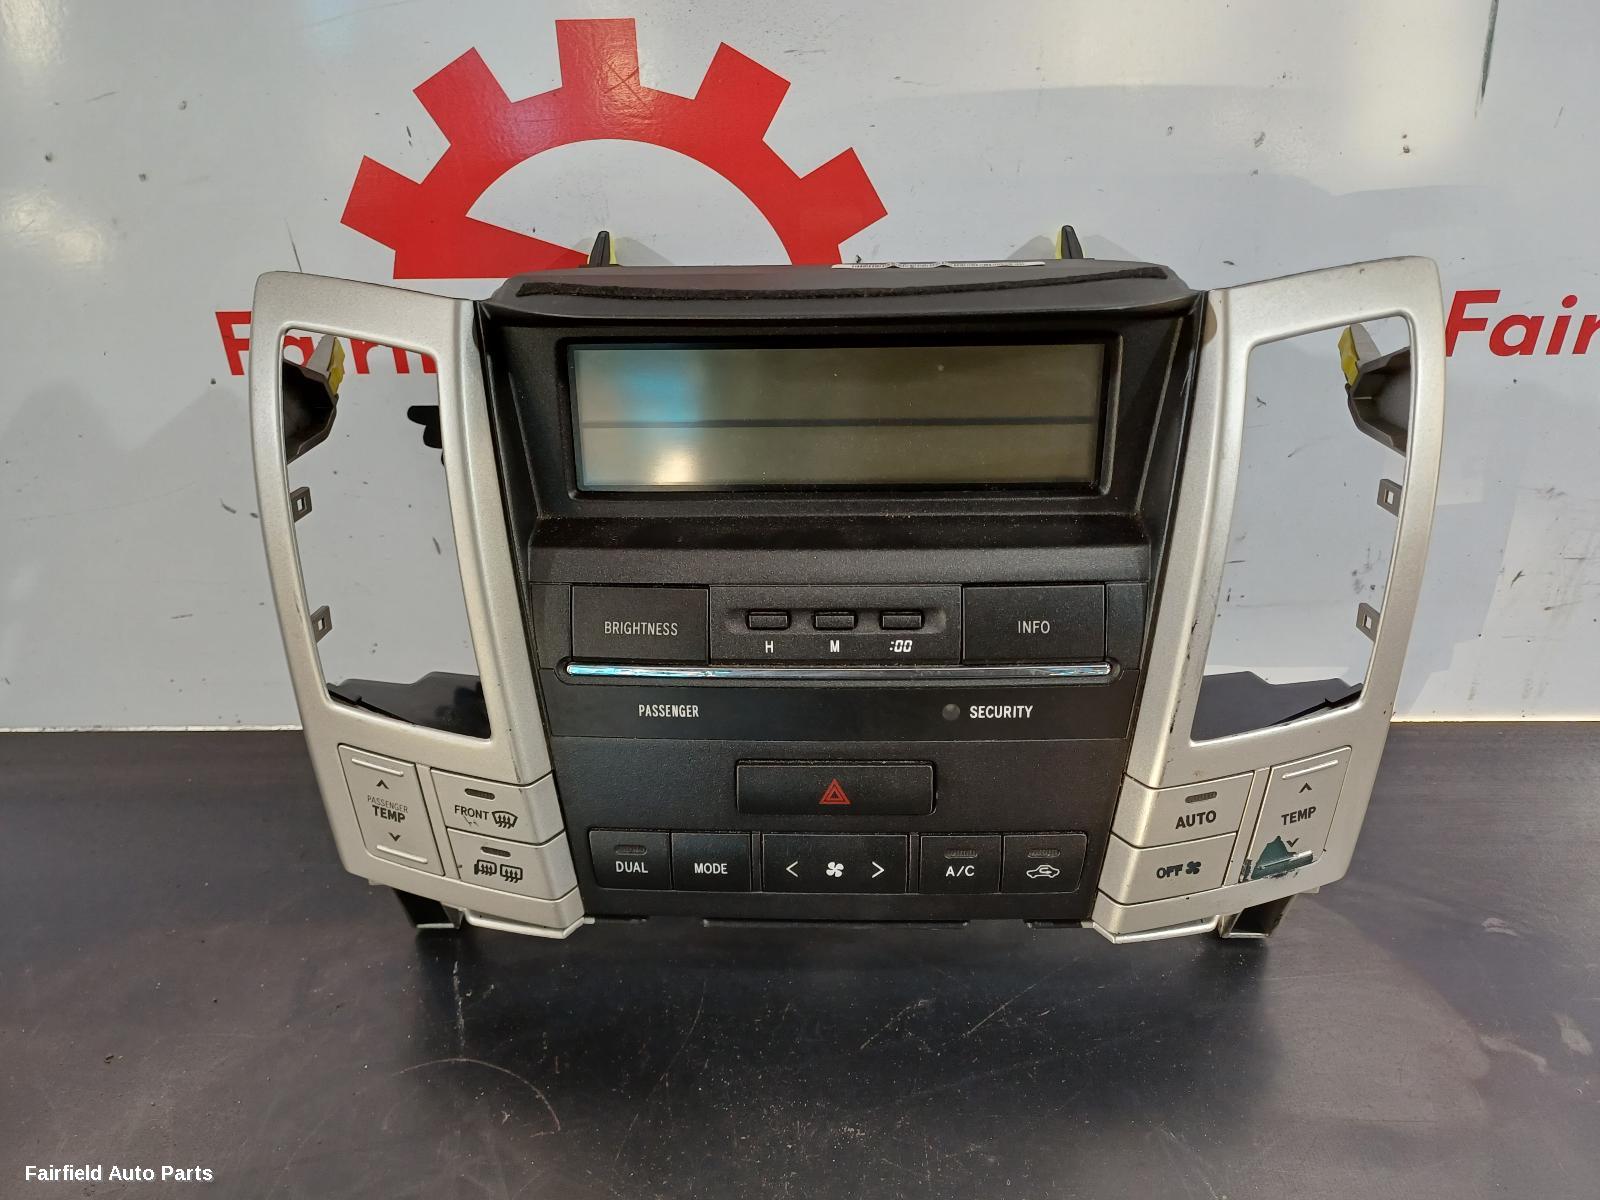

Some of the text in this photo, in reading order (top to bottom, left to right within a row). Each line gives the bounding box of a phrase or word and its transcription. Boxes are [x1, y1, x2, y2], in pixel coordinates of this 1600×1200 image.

[604, 621, 678, 636] BRIGHTNESS
[1017, 620, 1051, 634] INFO
[765, 640, 774, 653] H
[829, 640, 840, 653] M
[889, 639, 913, 653] :00
[638, 704, 700, 718] PASSENGER
[969, 705, 1034, 719] SECURITY
[367, 794, 409, 814] PASSENGER
[372, 804, 406, 823] TEMP
[454, 804, 490, 821] FRONT
[1175, 809, 1217, 830] AUTO
[1281, 806, 1317, 826] TEMP
[615, 860, 649, 874] DUAL
[694, 862, 728, 875] MODE
[945, 865, 976, 877] A/C
[1156, 863, 1184, 880] OFF
